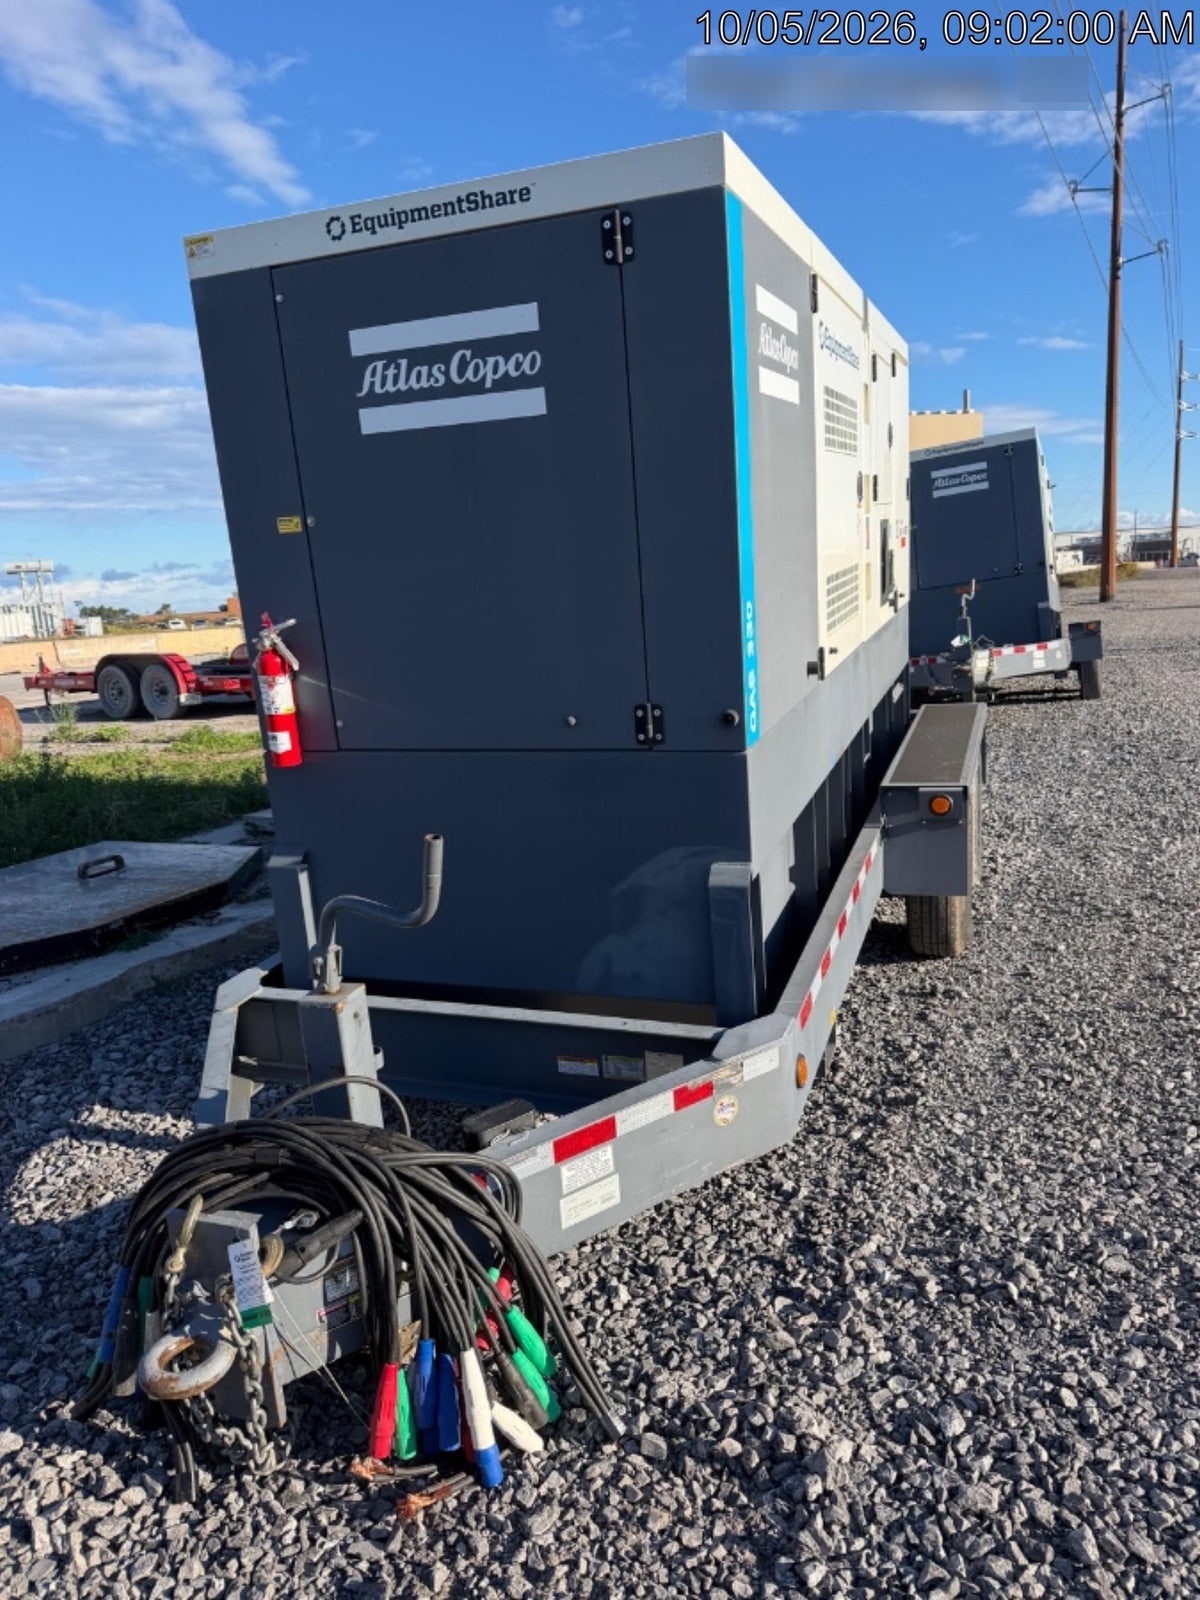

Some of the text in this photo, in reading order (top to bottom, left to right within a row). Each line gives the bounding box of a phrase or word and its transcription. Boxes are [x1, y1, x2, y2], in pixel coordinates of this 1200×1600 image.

[349, 185, 531, 235] EquipmentShare
[357, 349, 542, 397] Atlas Copco
